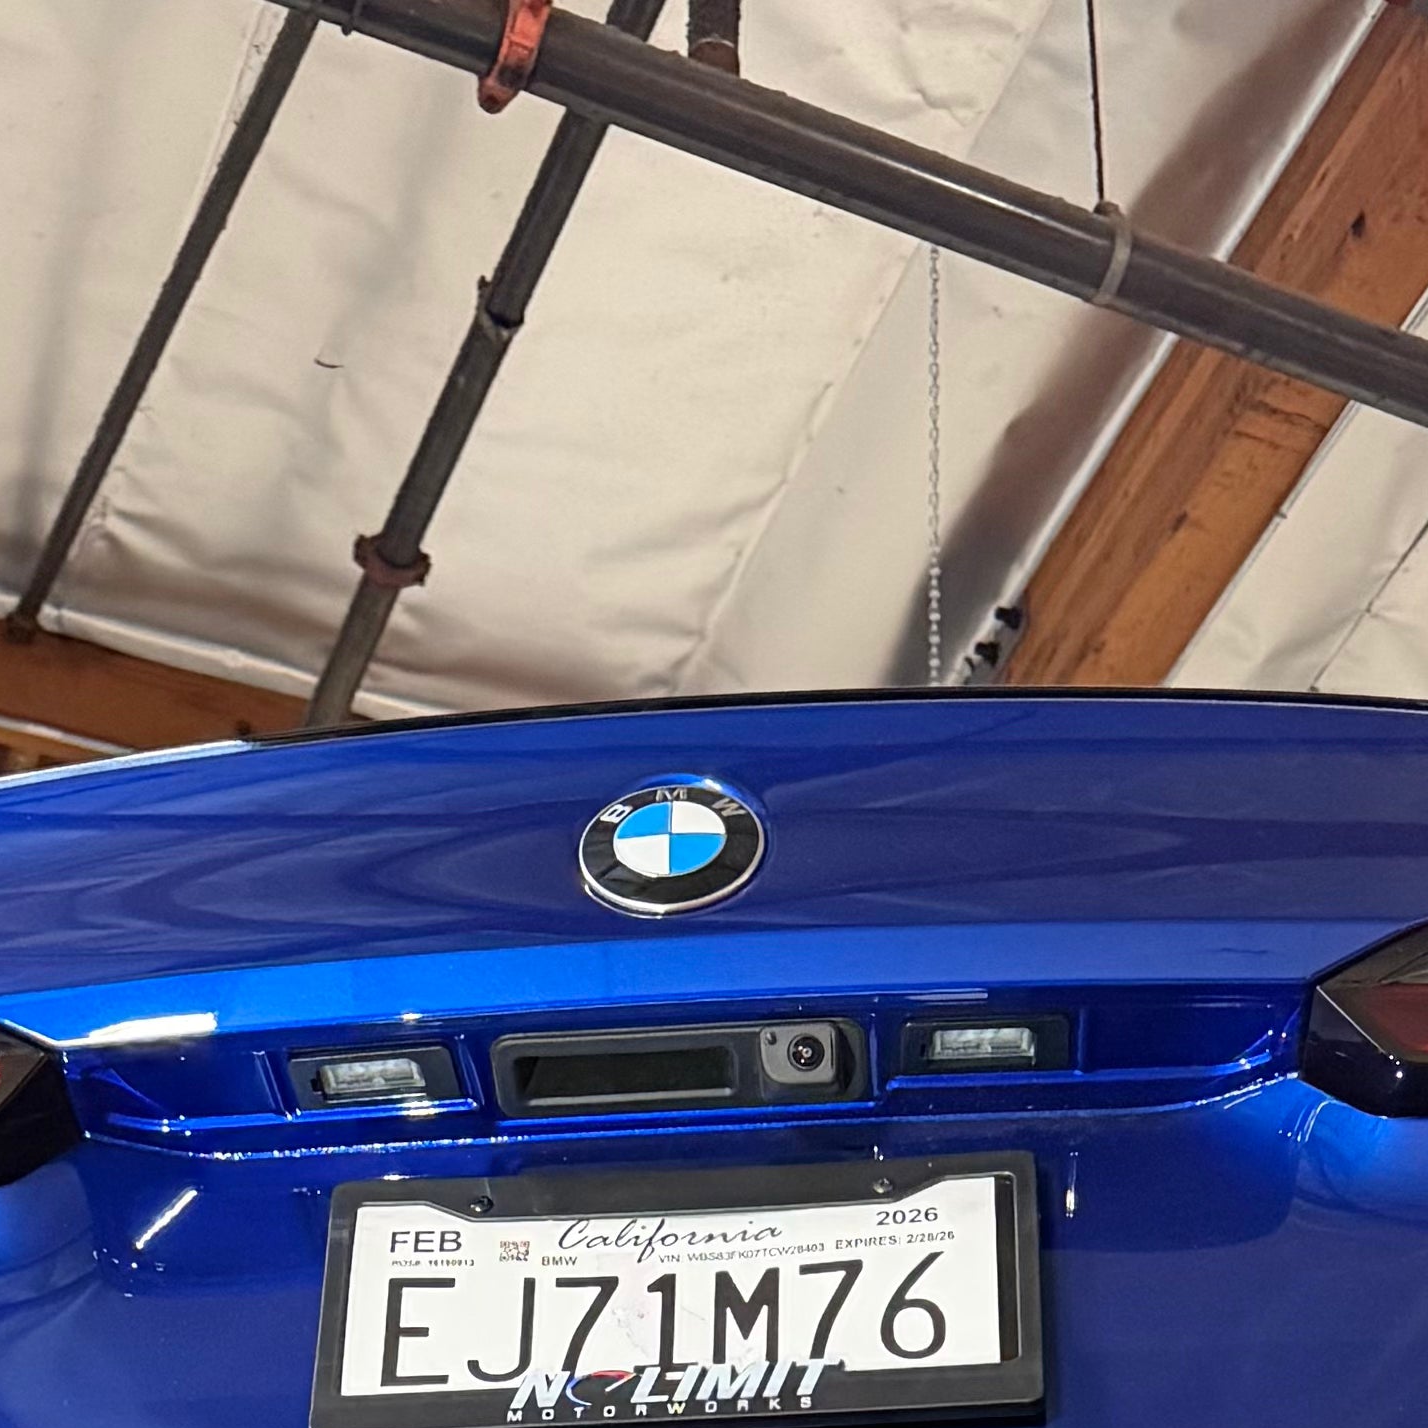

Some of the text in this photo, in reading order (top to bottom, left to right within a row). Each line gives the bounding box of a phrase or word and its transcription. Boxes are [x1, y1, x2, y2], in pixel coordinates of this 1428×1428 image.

[599, 786, 748, 824] BMW
[389, 1207, 939, 1264] FEB California 2026
[541, 1256, 578, 1266] BMW
[380, 1250, 950, 1388] EJ71M76
[629, 1358, 844, 1404] LIMIT
[506, 1397, 813, 1423] MOTORWORKS
